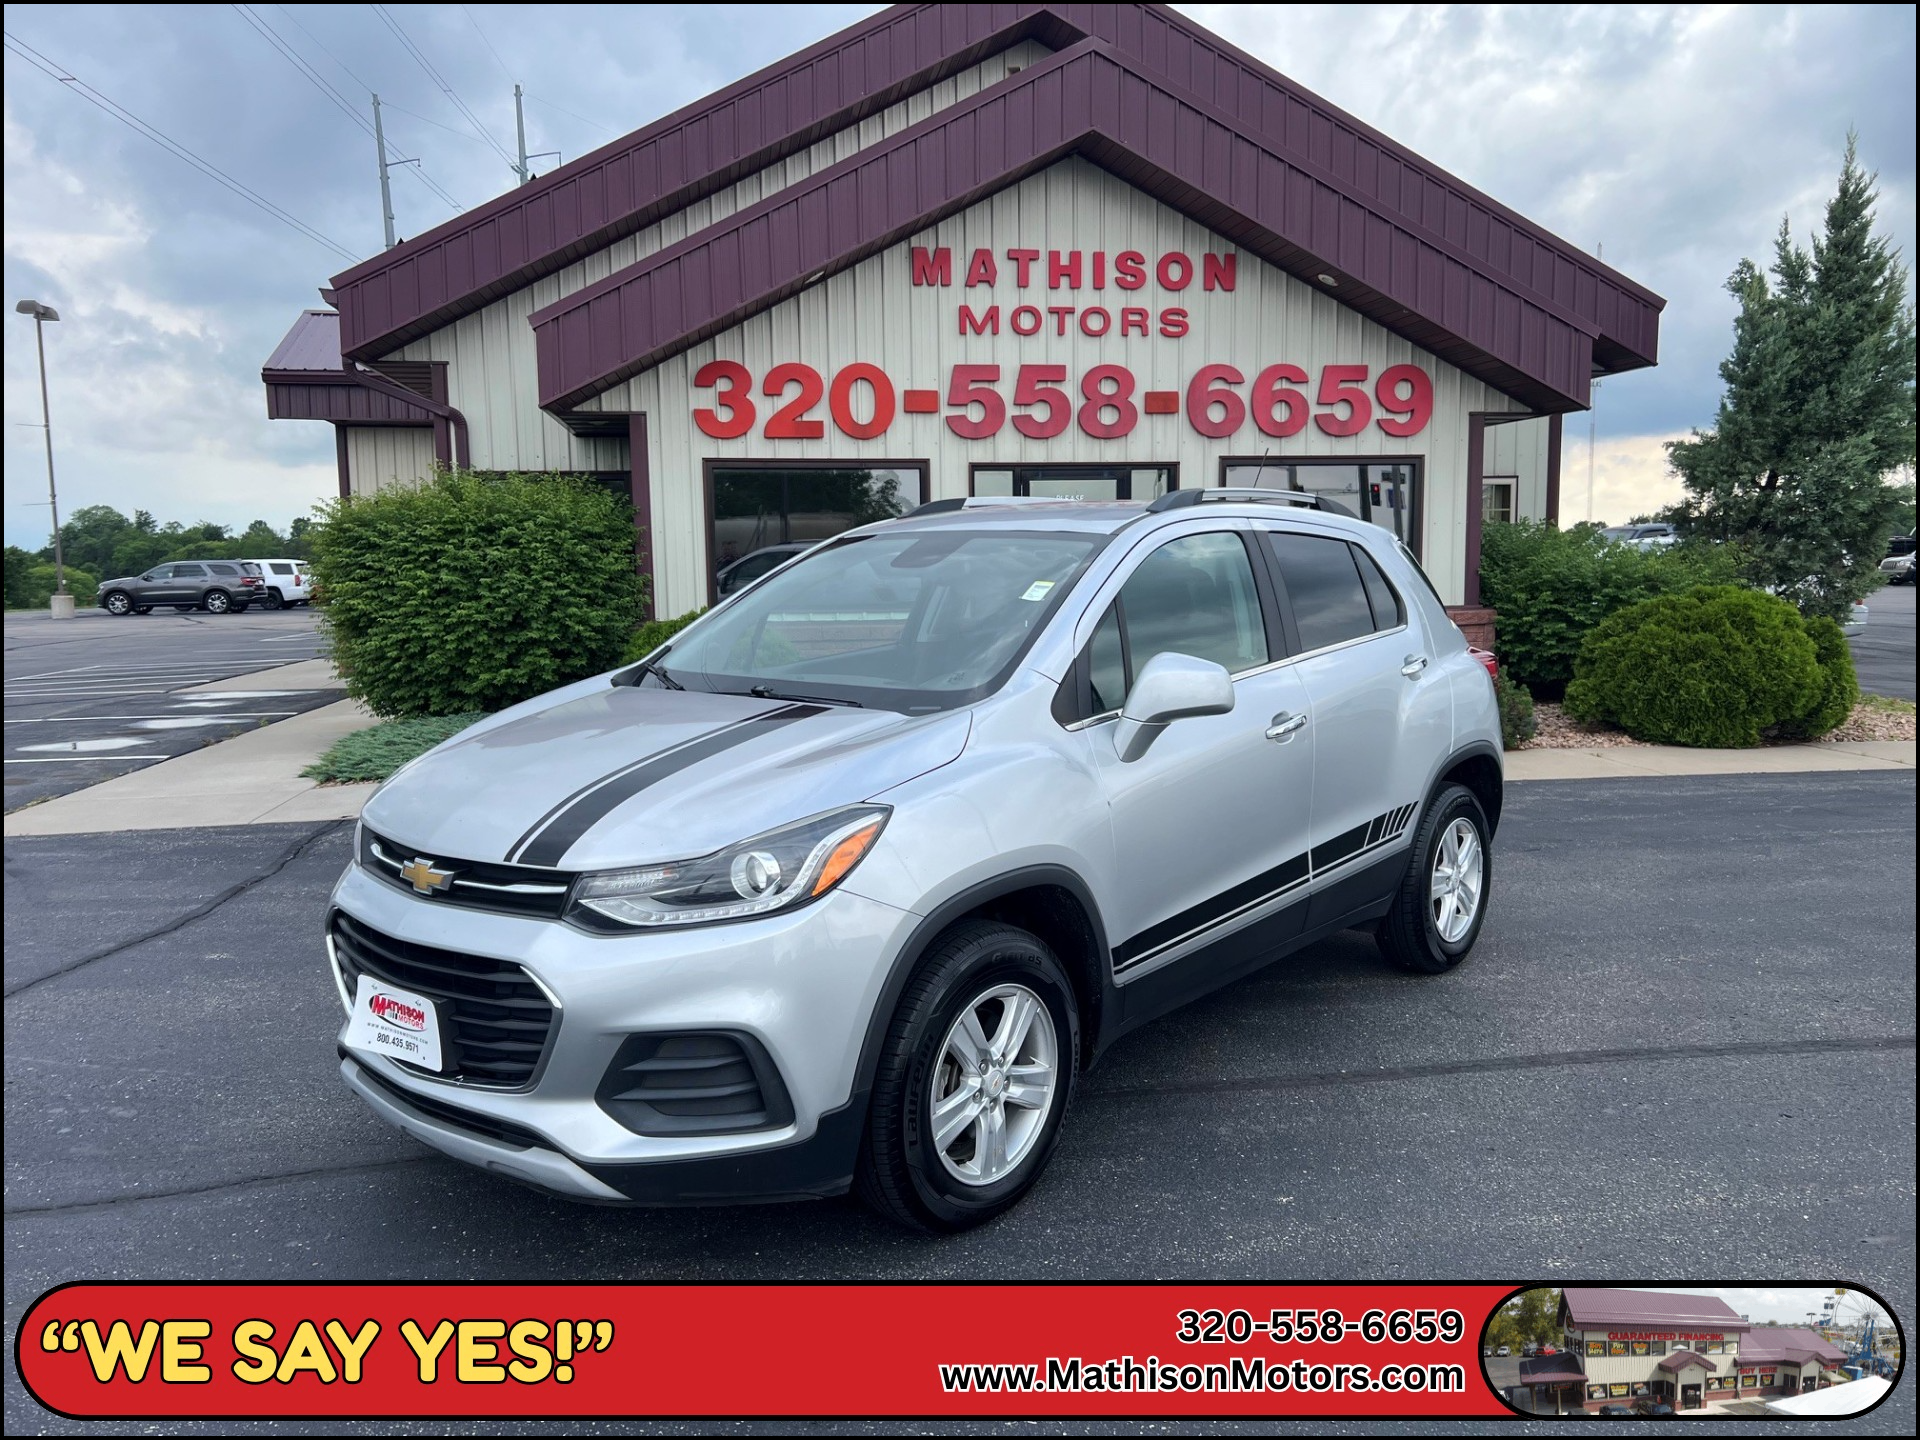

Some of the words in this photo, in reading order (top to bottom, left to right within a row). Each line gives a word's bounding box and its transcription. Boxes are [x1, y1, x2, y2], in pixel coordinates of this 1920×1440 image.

[911, 246, 1236, 291] MATHISON
[958, 305, 1190, 337] MOTORS
[693, 360, 1434, 440] 320-558-6659
[371, 994, 425, 1023] MATHISON
[398, 1014, 424, 1030] MOTORS
